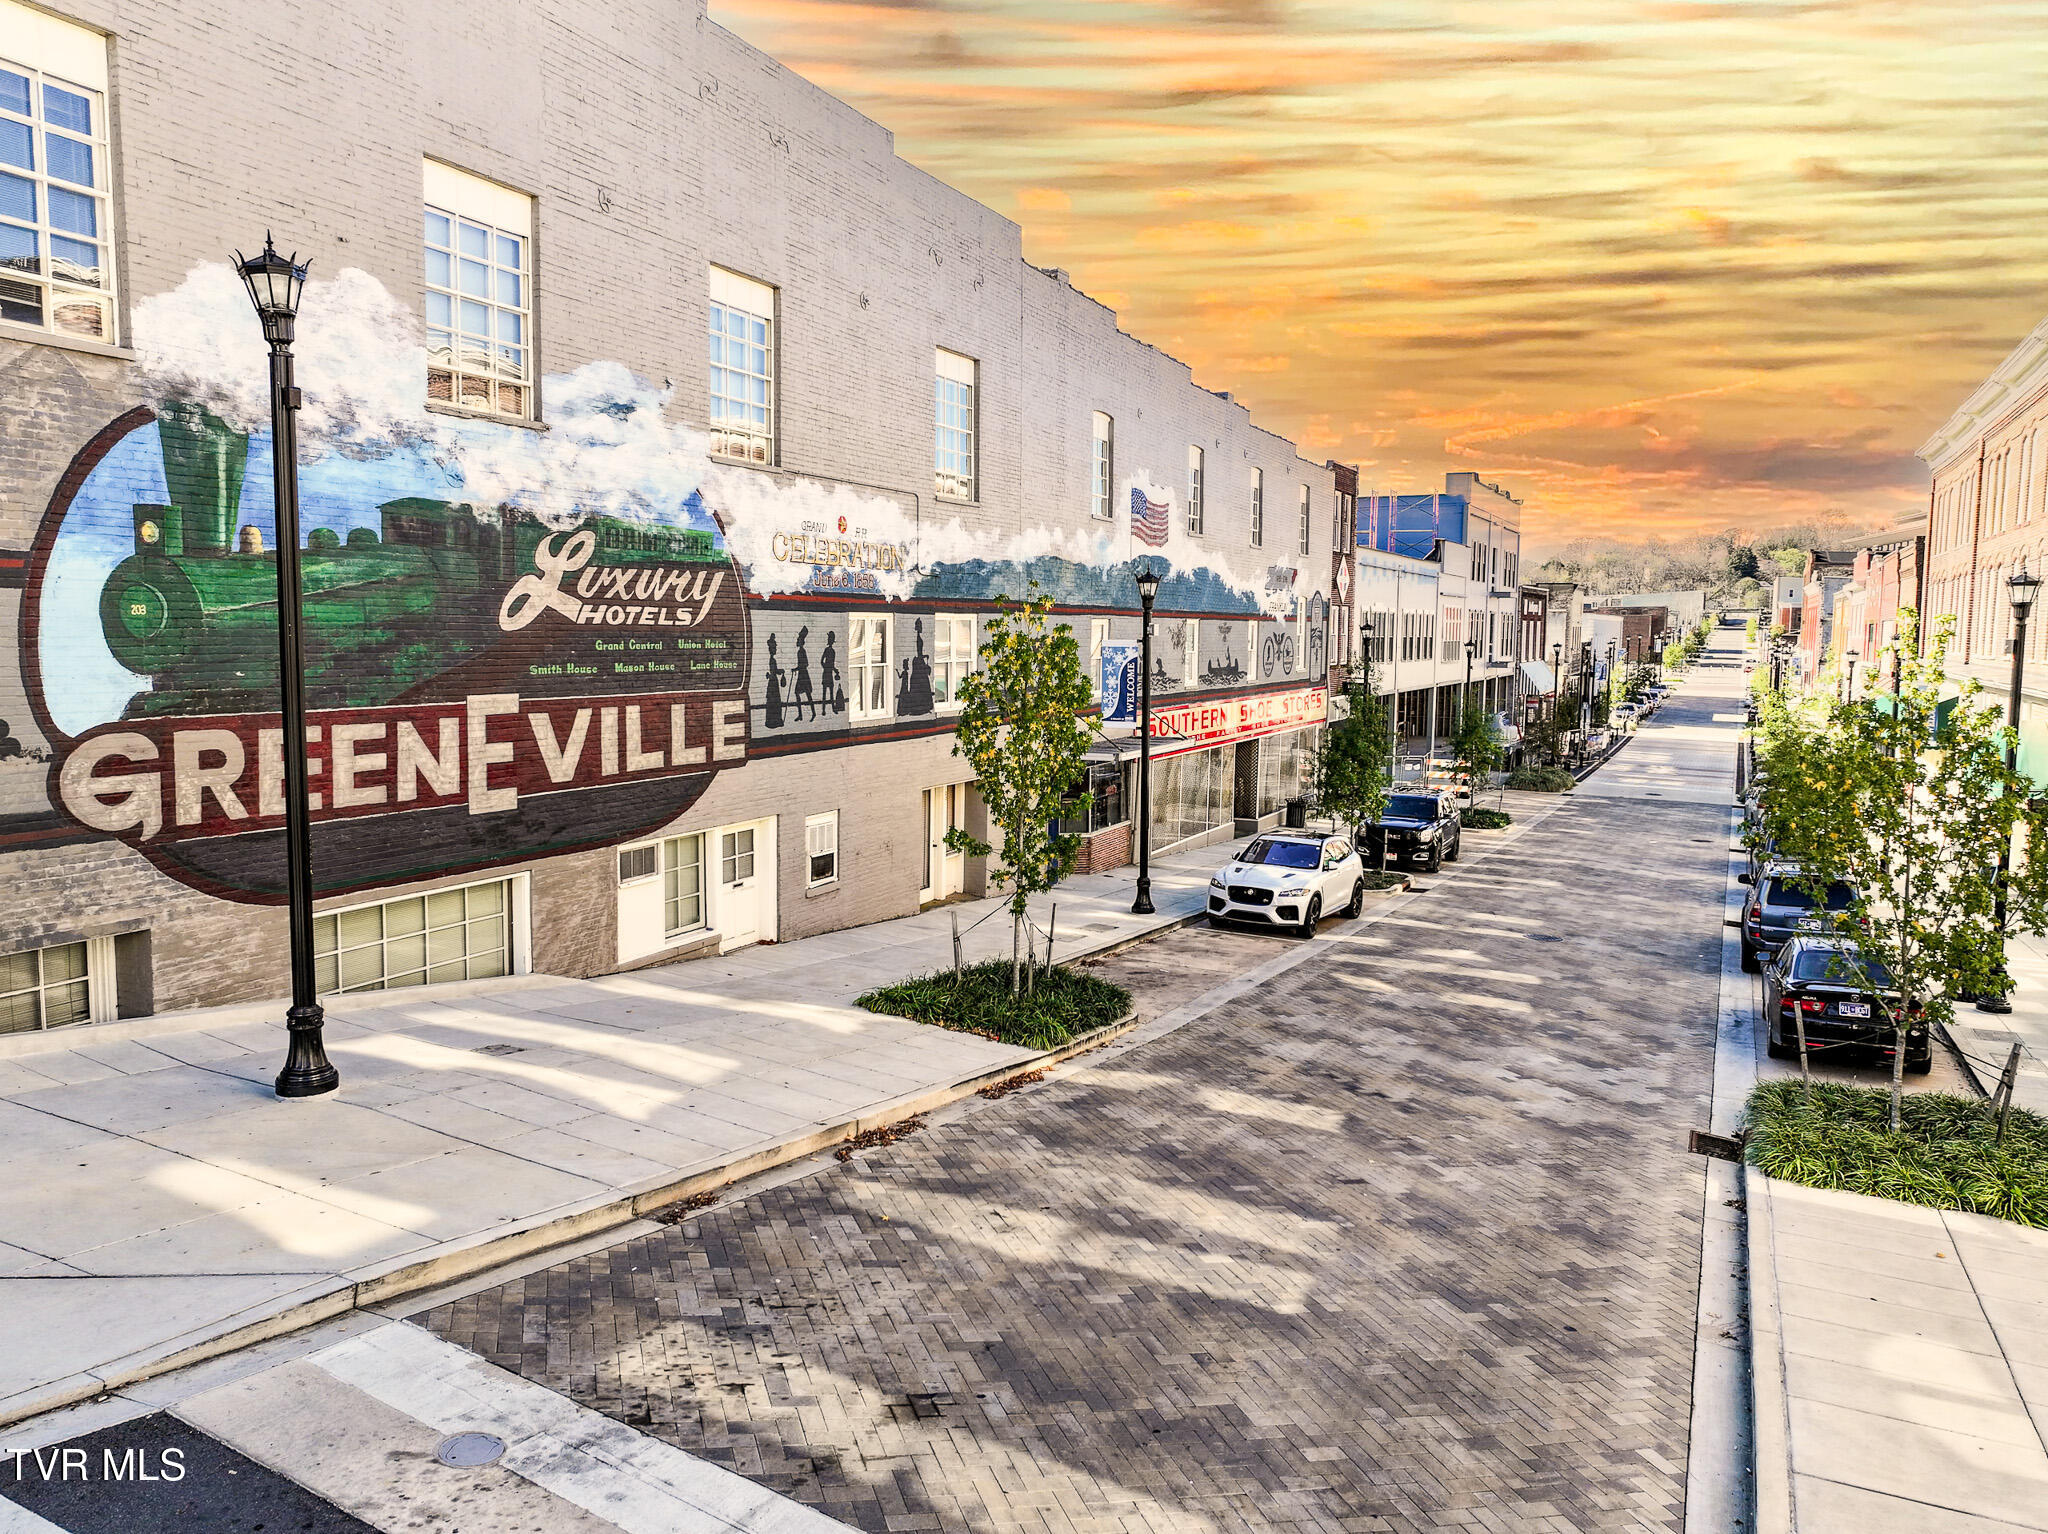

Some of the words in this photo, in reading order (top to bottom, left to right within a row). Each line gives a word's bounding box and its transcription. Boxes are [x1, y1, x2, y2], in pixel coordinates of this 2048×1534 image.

[772, 531, 904, 571] CELEBRATION
[499, 530, 725, 631] Luxury
[814, 569, 840, 588] June
[577, 604, 694, 626] HOTELS
[595, 639, 624, 651] Grand
[629, 639, 663, 650] Central
[678, 639, 702, 650] Union
[705, 639, 727, 649] Hotel
[529, 663, 562, 675] Smith
[567, 662, 598, 674] House
[614, 662, 645, 673] Mason
[648, 661, 676, 672] House
[690, 660, 711, 670] Lane
[713, 659, 738, 669] House
[1126, 661, 1136, 713] WELCOME
[1148, 706, 1227, 738] SOUTHERN
[1240, 700, 1273, 722] SHOE
[1282, 692, 1322, 715] STORES
[60, 692, 748, 842] GREENEVILLE
